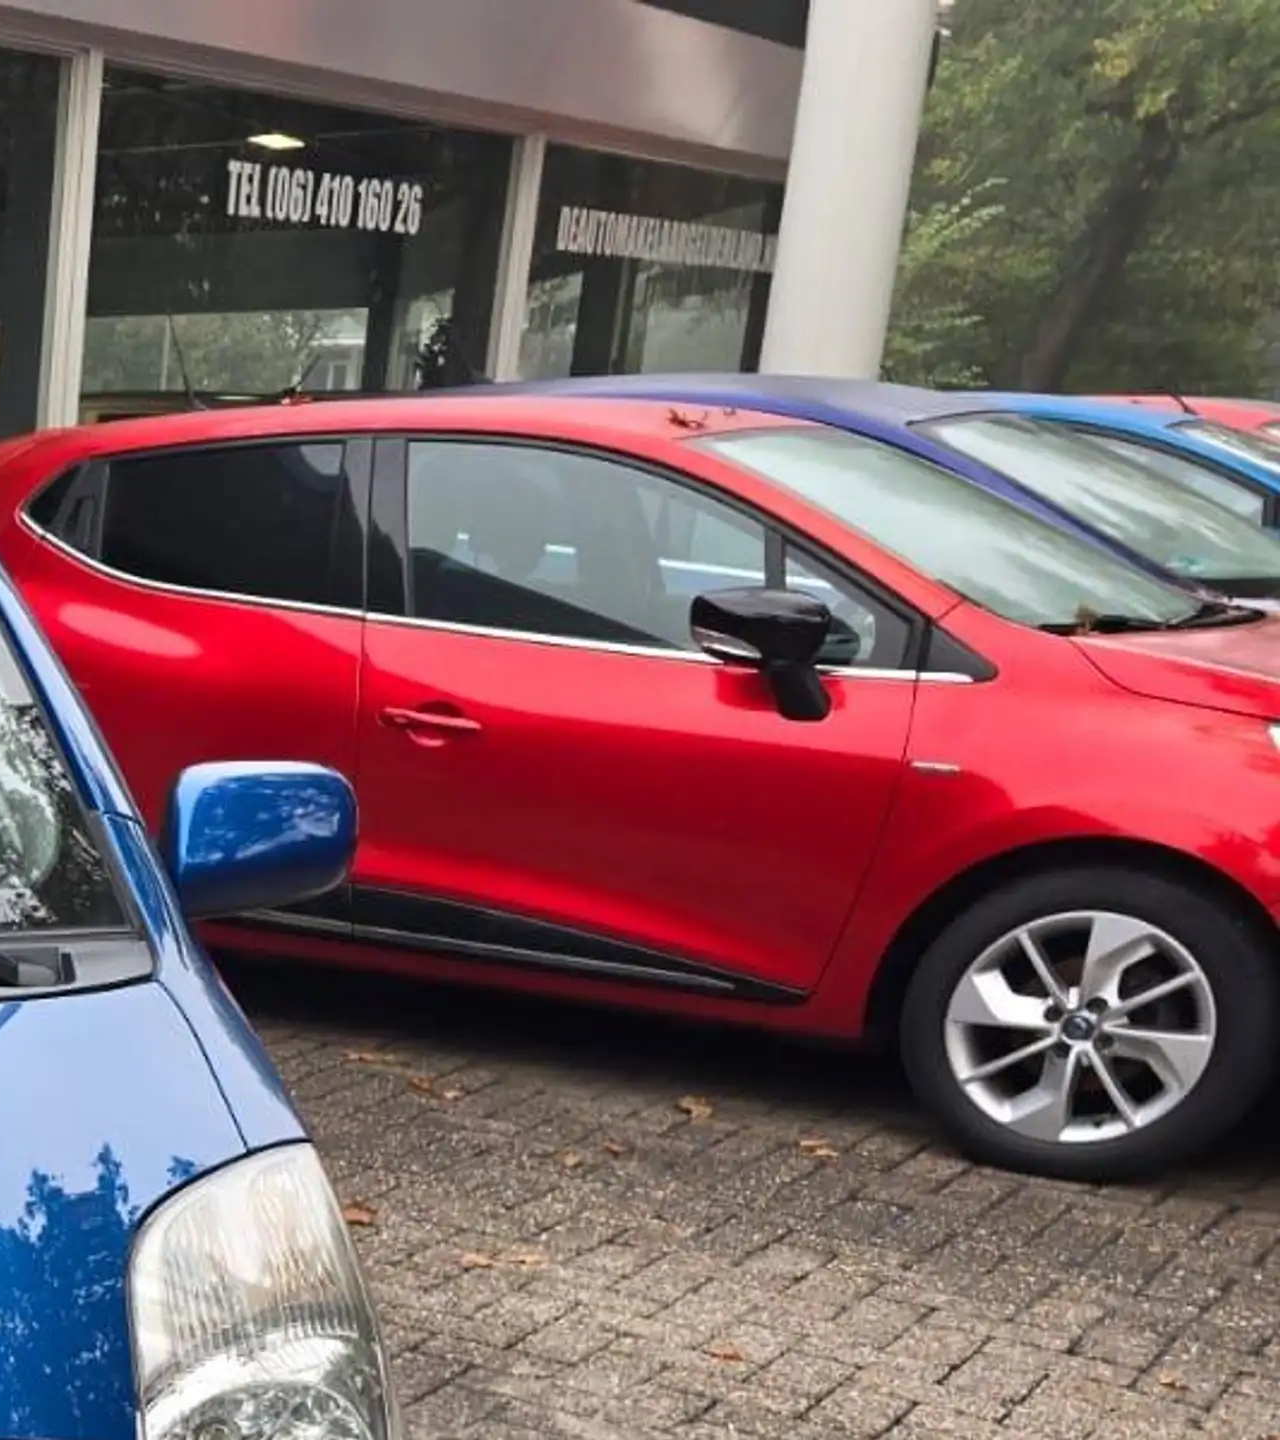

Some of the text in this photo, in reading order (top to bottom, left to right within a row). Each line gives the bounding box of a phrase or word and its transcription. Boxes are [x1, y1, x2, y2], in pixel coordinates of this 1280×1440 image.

[227, 158, 424, 235] TEL (06) 410 160 26
